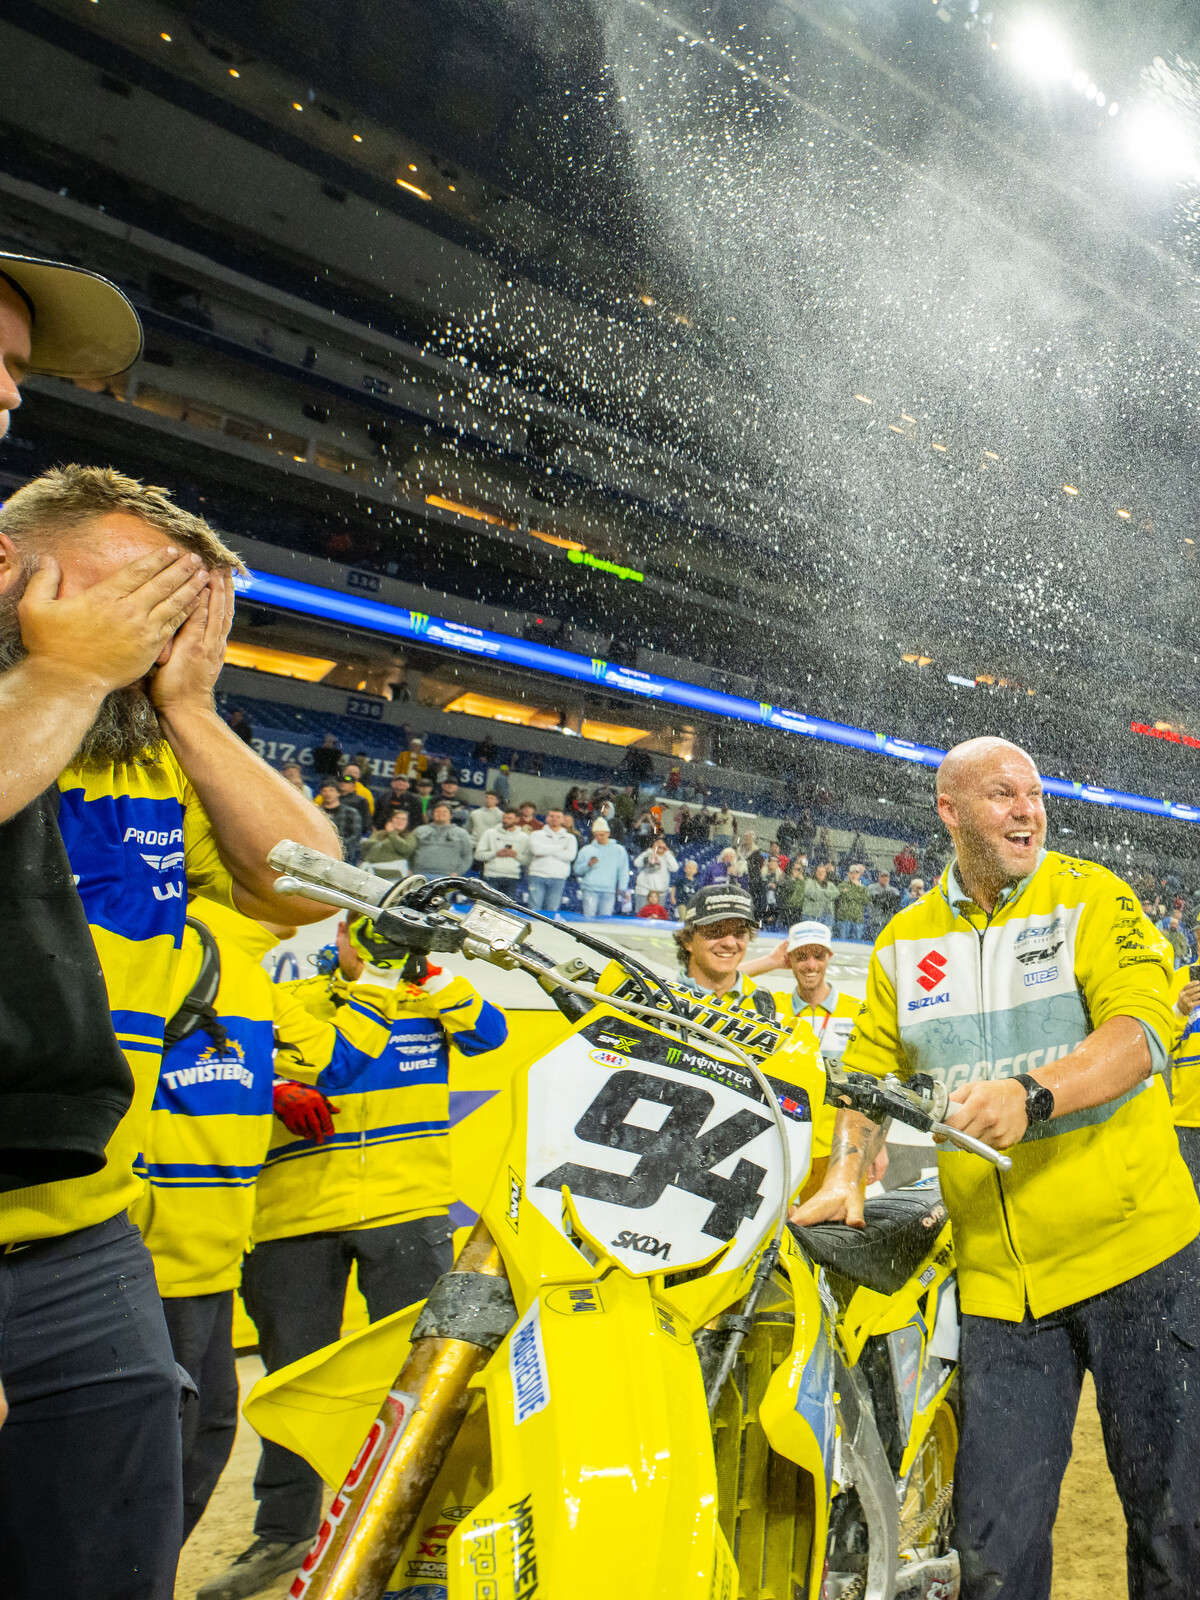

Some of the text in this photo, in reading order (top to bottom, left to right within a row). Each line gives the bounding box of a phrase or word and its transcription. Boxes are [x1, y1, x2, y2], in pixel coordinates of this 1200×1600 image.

[907, 992, 951, 1011] SUZUKI
[682, 1052, 753, 1089] MONSTER
[691, 1067, 742, 1090] ENERGY
[532, 1069, 775, 1243] 94
[611, 1230, 672, 1261] SKDA
[513, 1320, 546, 1420] PROGRESSIVE
